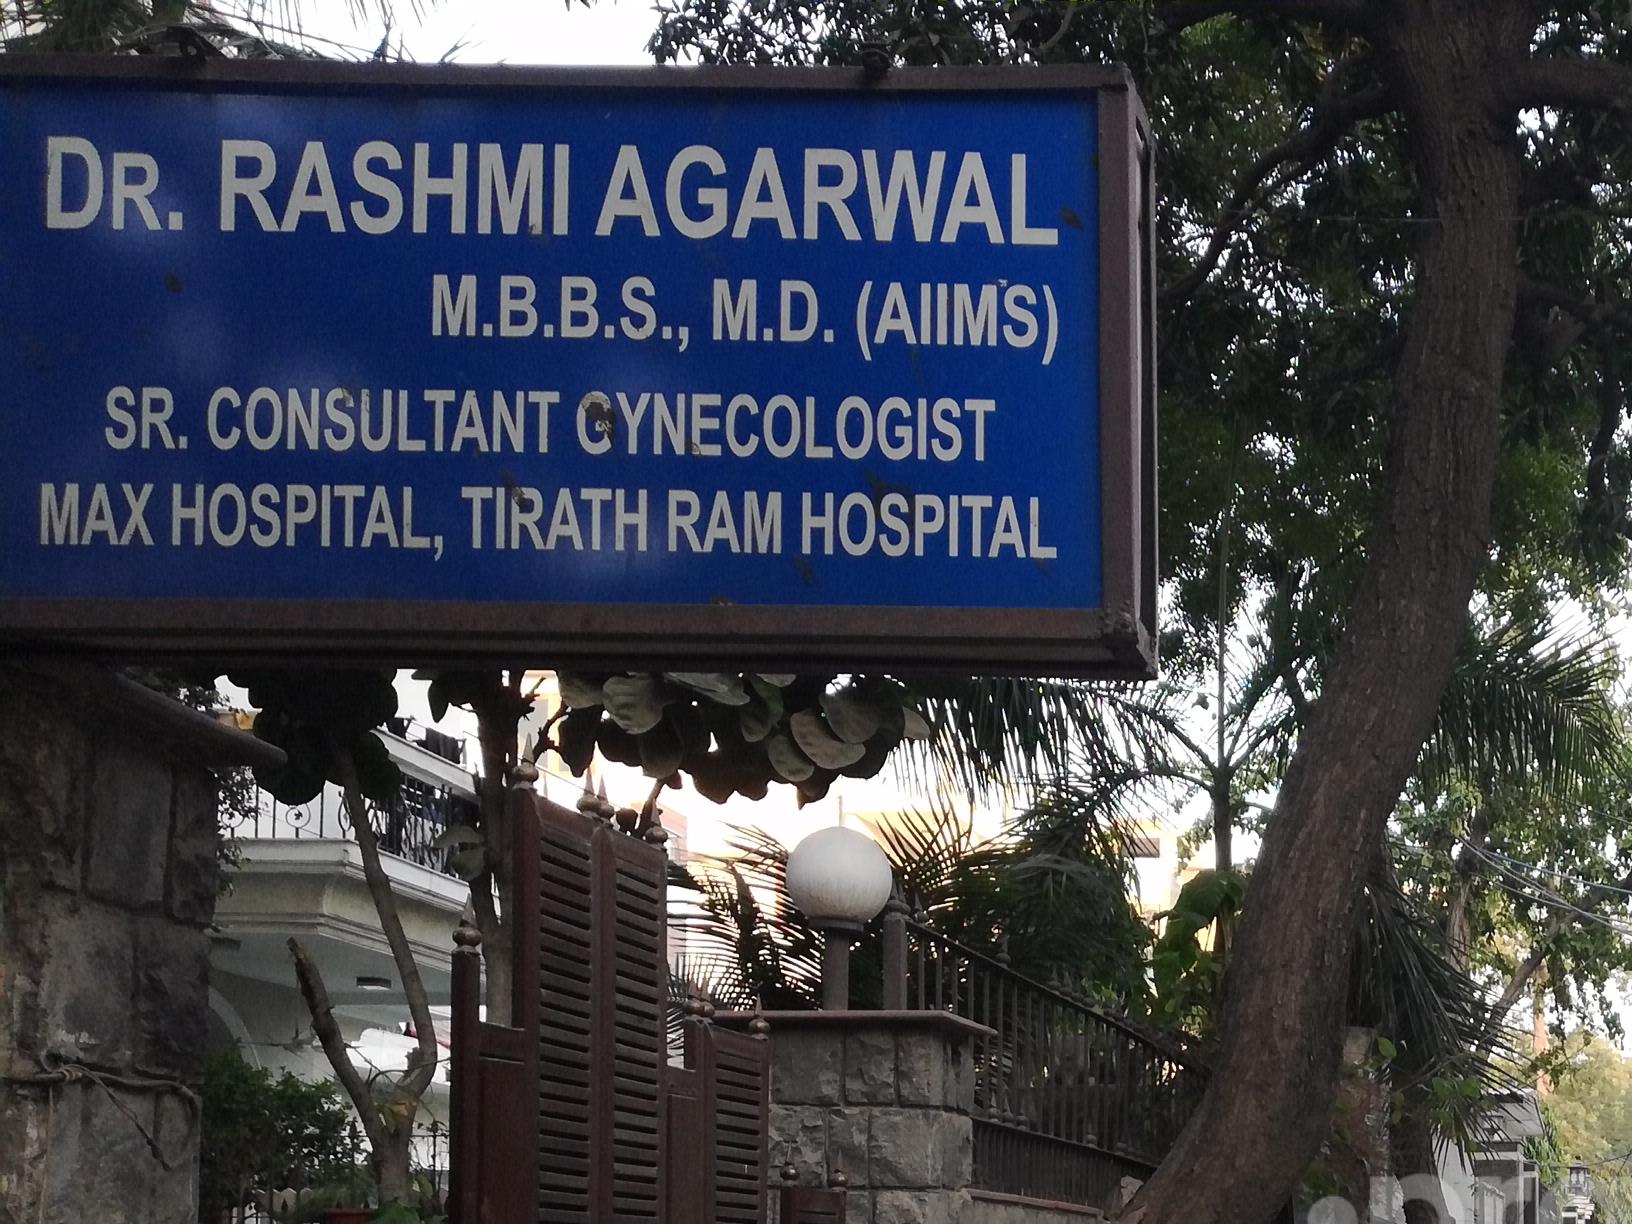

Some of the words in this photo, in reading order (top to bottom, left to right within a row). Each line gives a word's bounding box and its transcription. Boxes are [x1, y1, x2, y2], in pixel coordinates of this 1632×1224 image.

[221, 140, 569, 235] RASHMI
[595, 145, 1058, 245] AGARWAL
[433, 275, 688, 352] M.B.B.S.,
[713, 279, 833, 342] M.D.
[857, 281, 1058, 364] (AIIMS)
[106, 387, 186, 449] SR.
[208, 387, 559, 452] CONSULTANT
[577, 391, 995, 461] GYNECOLOGIST
[42, 484, 153, 544] MAX
[173, 484, 442, 560] HOSPITAL,
[462, 487, 647, 551] TIRATH
[669, 490, 781, 553] RAM
[802, 493, 1056, 558] HOSPITAL
